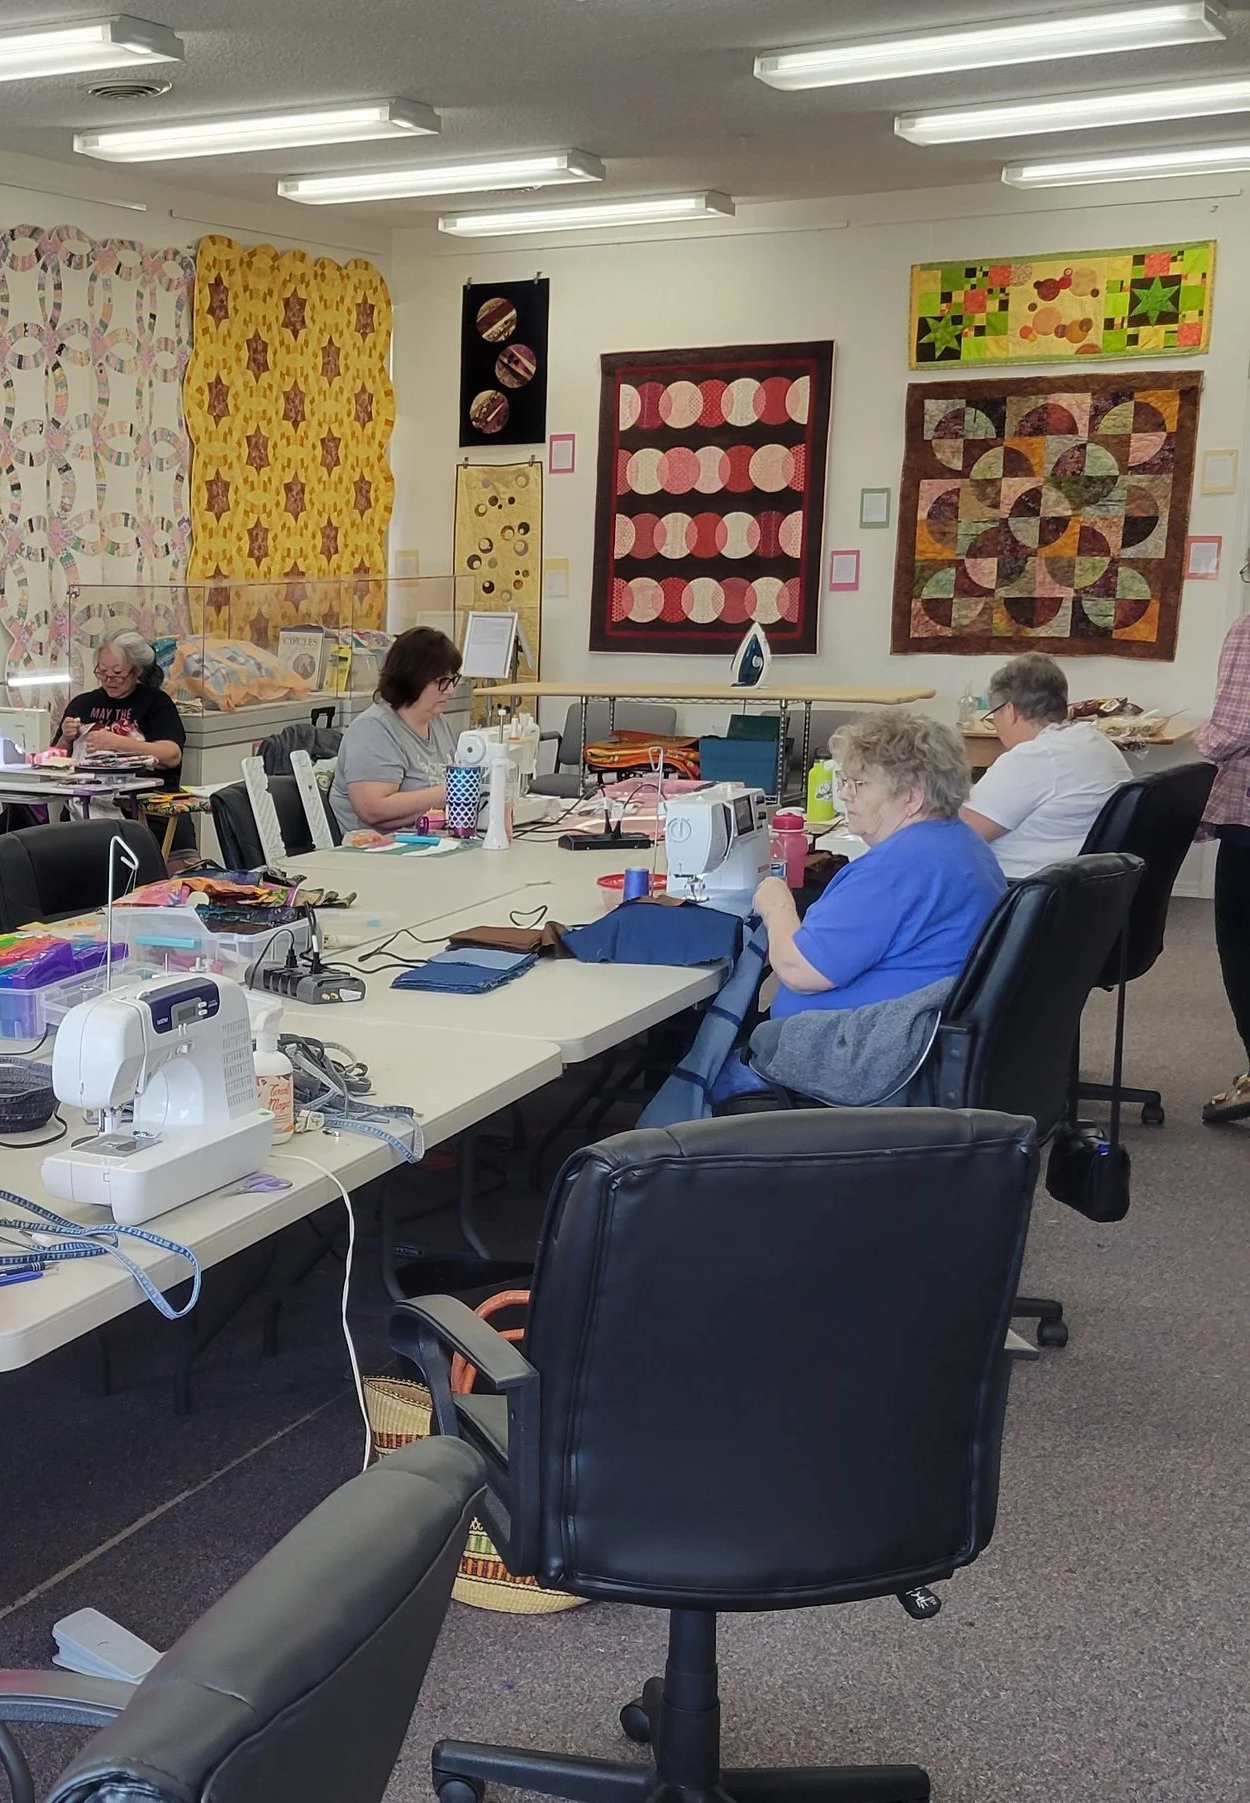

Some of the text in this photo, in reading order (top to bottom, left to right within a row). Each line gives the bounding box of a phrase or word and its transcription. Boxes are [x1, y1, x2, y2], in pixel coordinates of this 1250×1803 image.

[282, 634, 318, 646] CIRCLES
[90, 707, 132, 720] MAY THE
